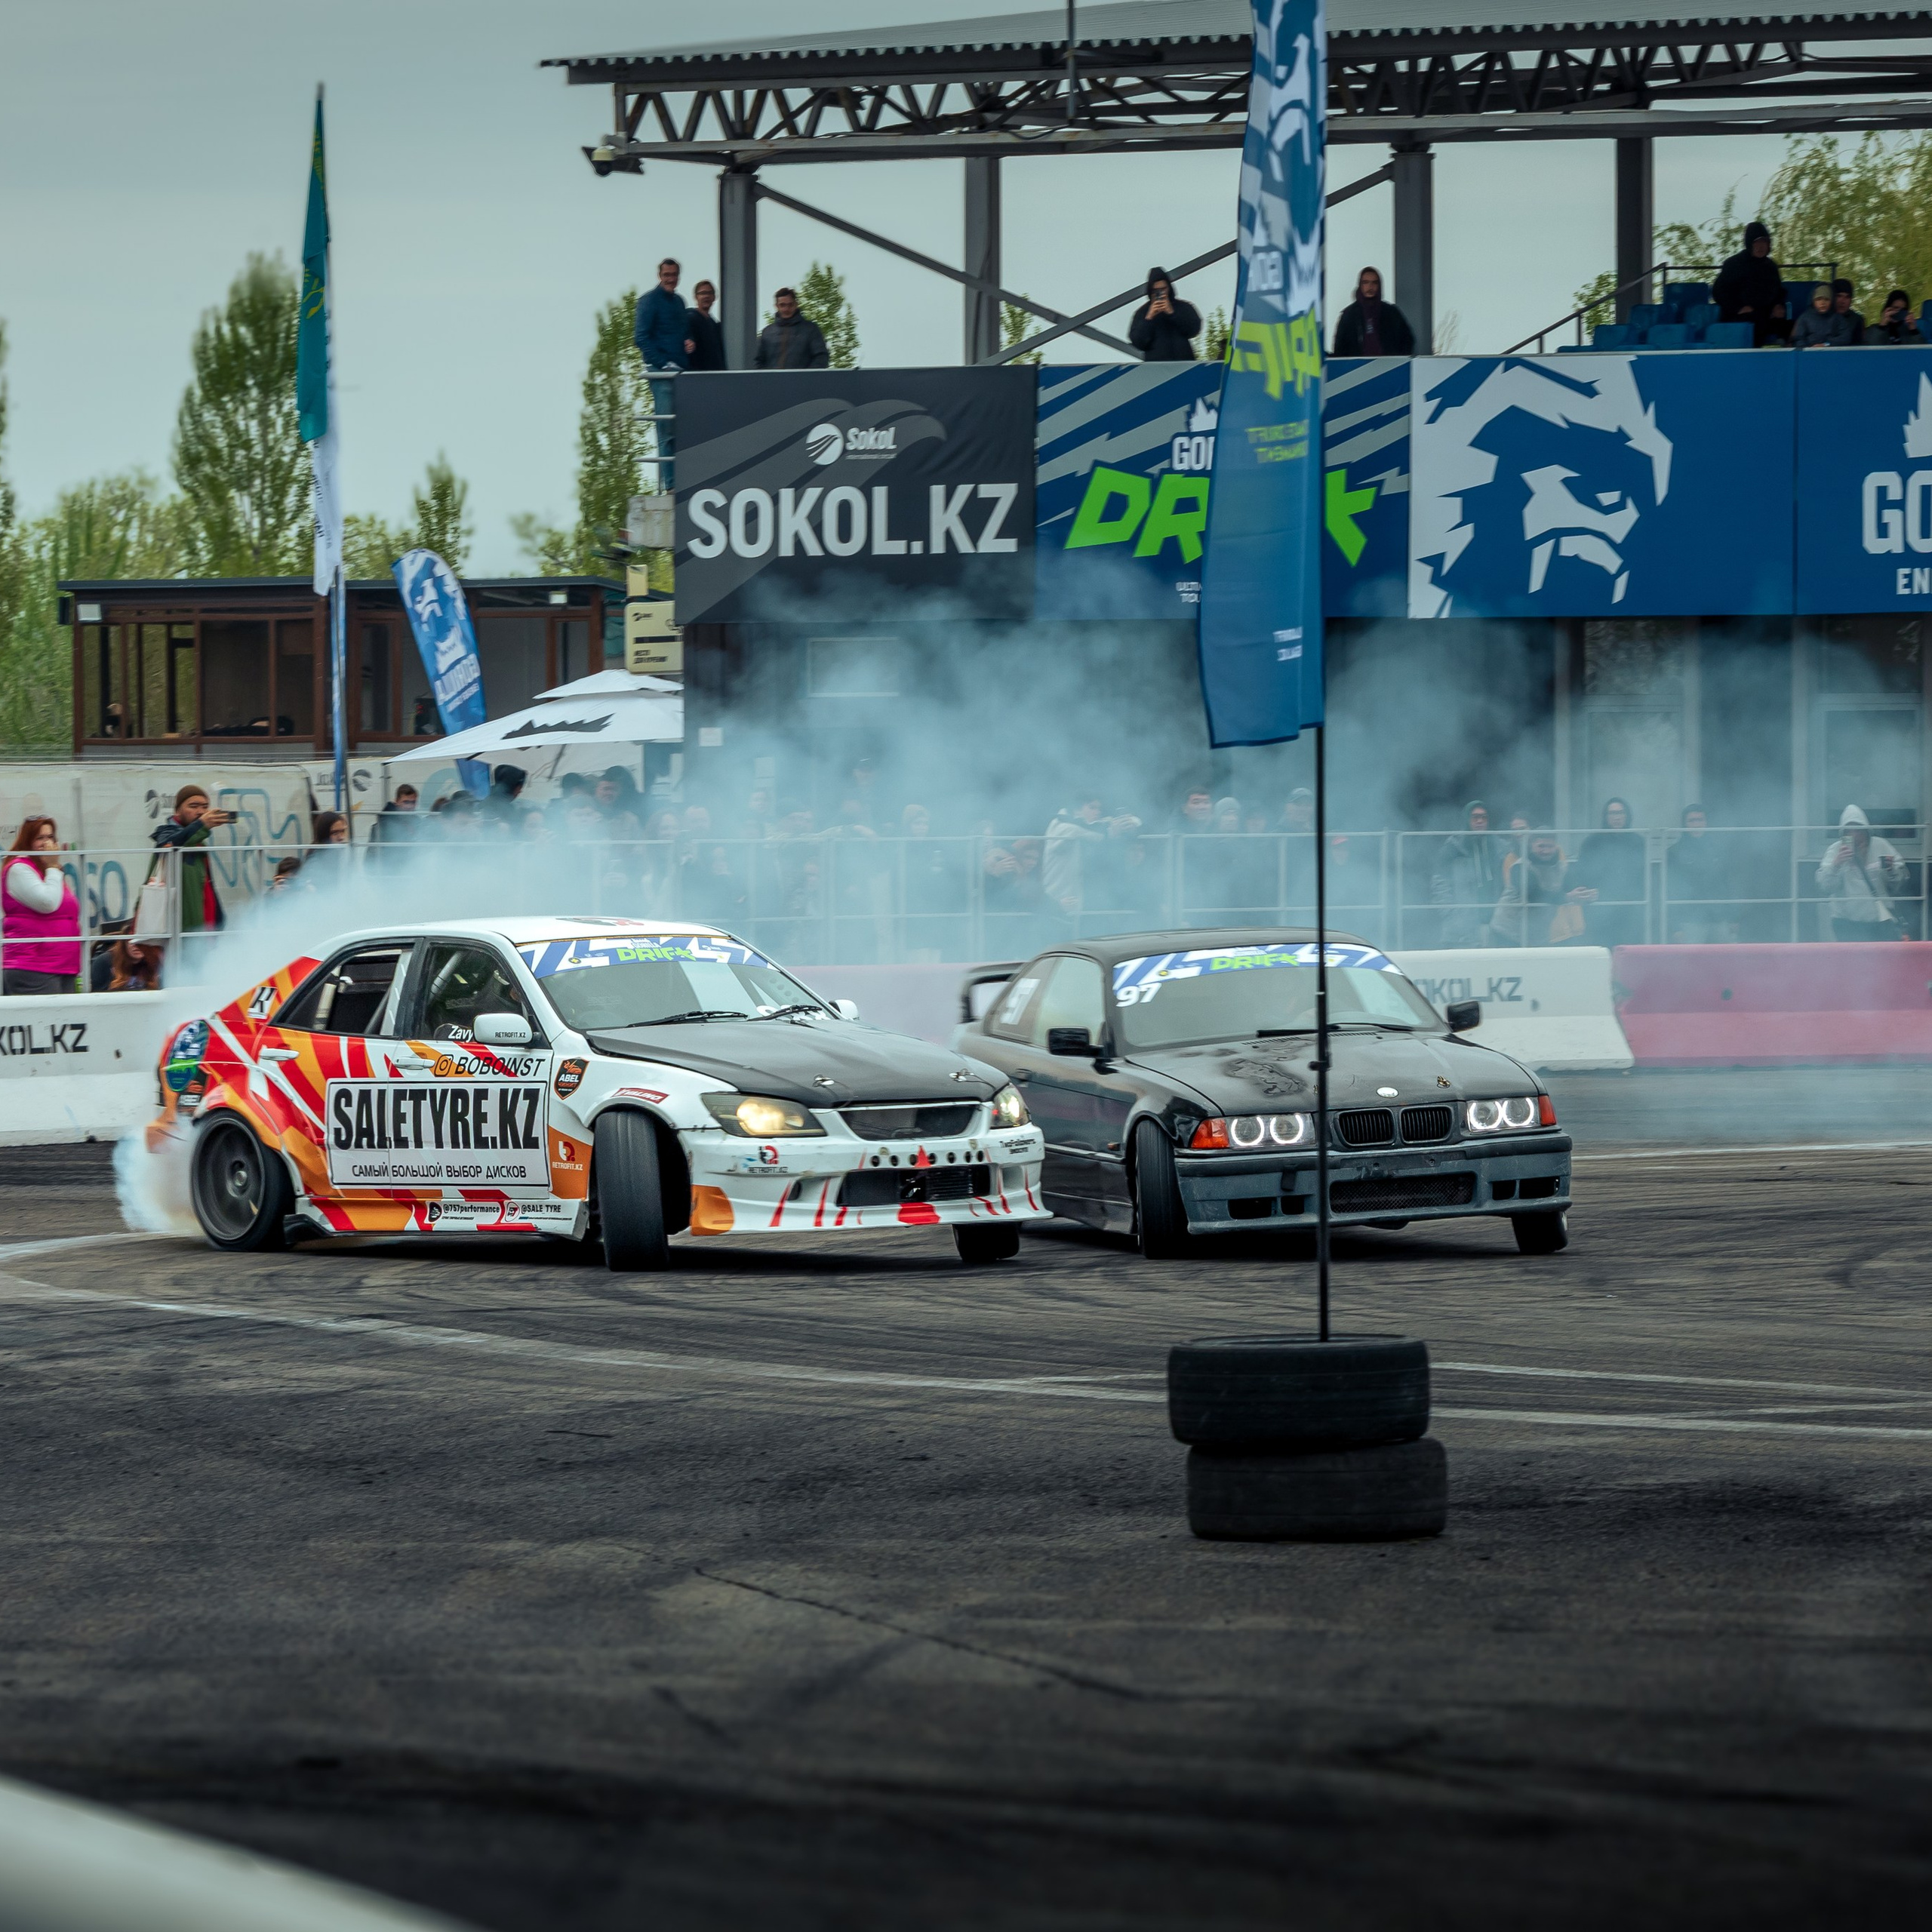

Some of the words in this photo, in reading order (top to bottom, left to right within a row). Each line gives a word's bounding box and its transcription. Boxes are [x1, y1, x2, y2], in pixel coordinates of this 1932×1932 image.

[687, 483, 1019, 559] SOKOL.KZ
[1115, 982, 1162, 1008] 97
[454, 1056, 546, 1077] BOBOINST
[558, 1074, 580, 1082] ABEL
[333, 1088, 541, 1151] SALETYRE.KZ
[352, 1161, 389, 1177] САМЫЙ
[392, 1162, 443, 1178] БОЛЬШОЙ
[446, 1165, 482, 1178] ВЫБОР
[485, 1165, 527, 1179] ДИСКОВ
[552, 1161, 583, 1171] RETROFIT.KZ
[443, 1204, 500, 1214] @757performance
